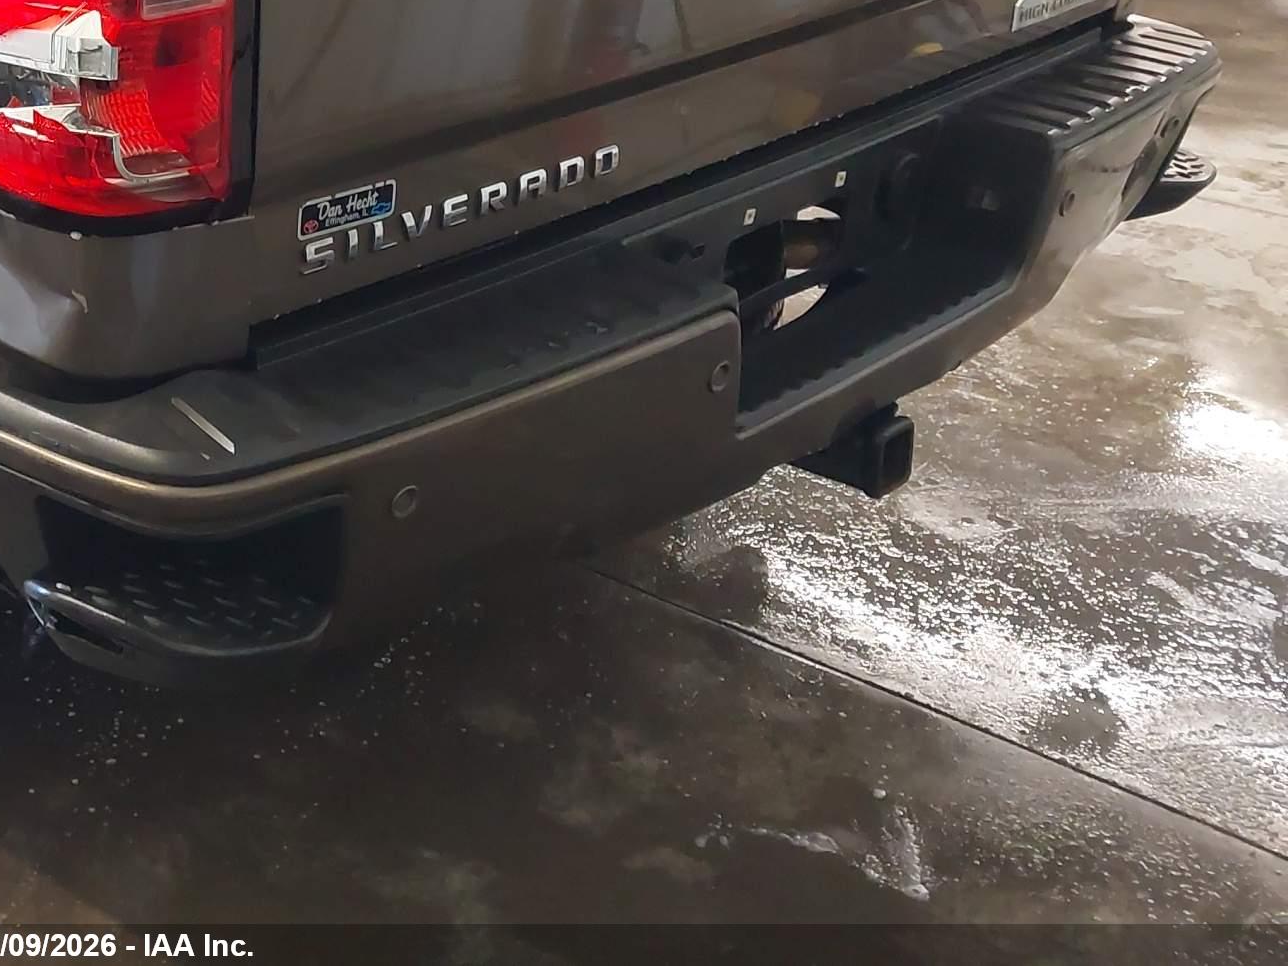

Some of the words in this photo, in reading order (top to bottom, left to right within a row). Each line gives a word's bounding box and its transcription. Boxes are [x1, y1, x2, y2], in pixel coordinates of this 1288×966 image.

[301, 144, 620, 275] SILVERADO
[317, 201, 343, 220] Dan
[346, 190, 380, 212] Hecht
